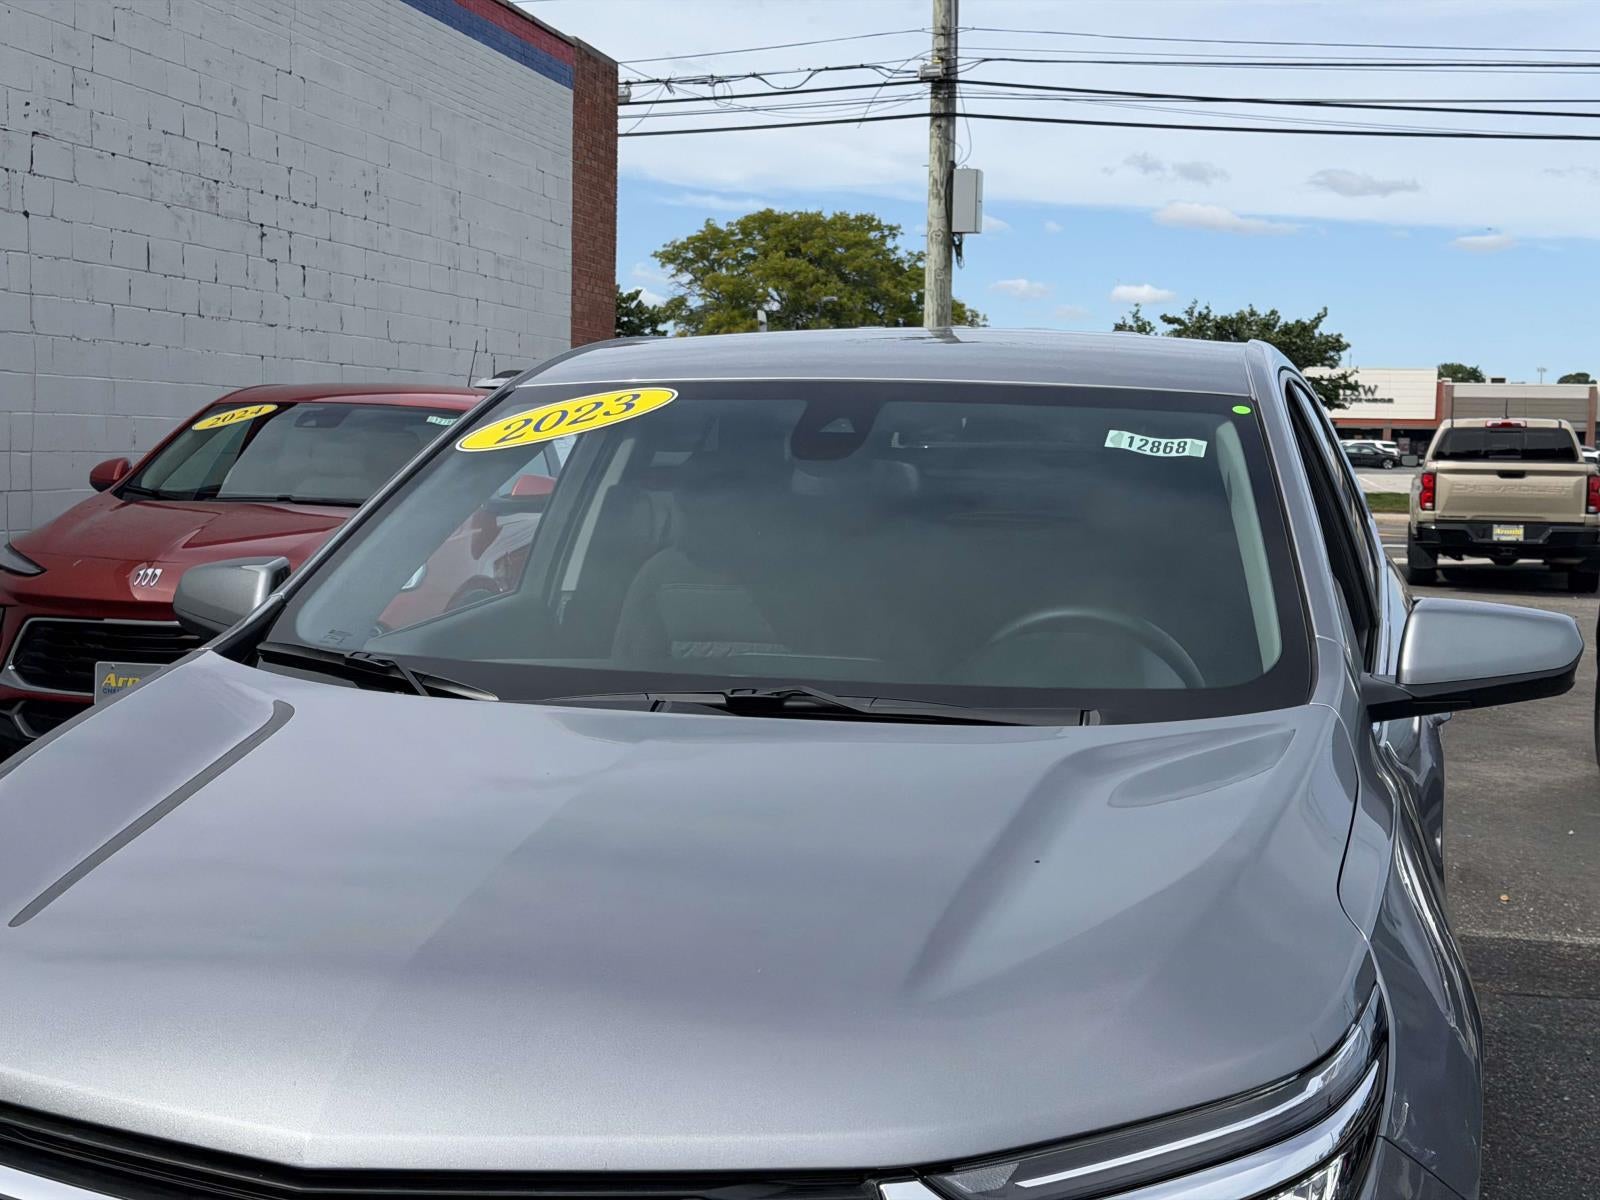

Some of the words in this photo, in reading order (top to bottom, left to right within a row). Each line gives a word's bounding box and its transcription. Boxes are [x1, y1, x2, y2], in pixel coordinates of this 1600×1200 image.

[207, 406, 263, 426] 2024
[494, 393, 641, 445] 2023
[1126, 435, 1188, 455] 12868
